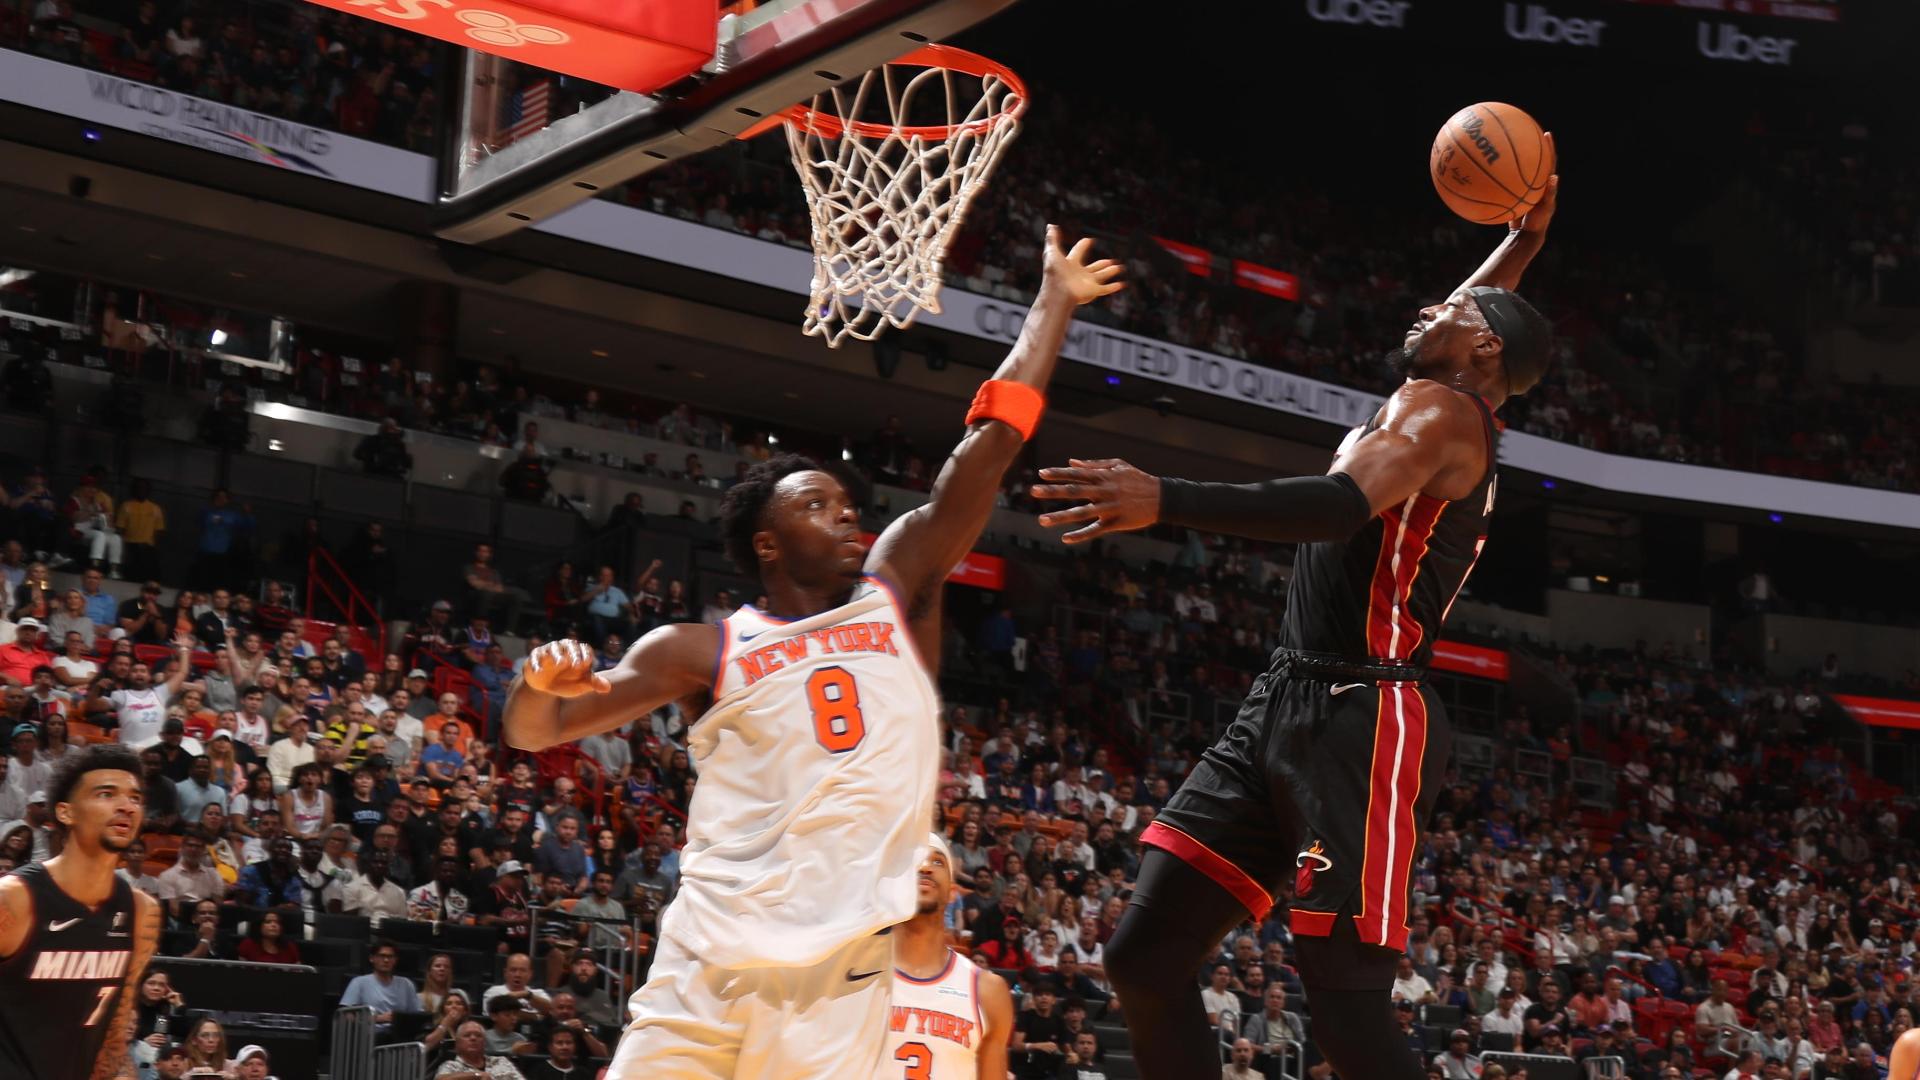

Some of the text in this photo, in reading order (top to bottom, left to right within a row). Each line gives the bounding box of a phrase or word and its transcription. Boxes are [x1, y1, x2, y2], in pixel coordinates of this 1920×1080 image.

[1306, 0, 1411, 28] Uber
[1503, 0, 1609, 47] Uber
[1696, 20, 1799, 65] Uber
[181, 97, 331, 156] PAINTING
[1461, 114, 1499, 166] ilson
[973, 303, 1369, 425] COMITTED TO QUALITY
[736, 621, 899, 687] NEW YORK
[804, 665, 866, 755] 8
[28, 950, 132, 980] MIAMI
[82, 986, 121, 1027] 7
[912, 1007, 974, 1049] YORK
[894, 1041, 933, 1080] 3
